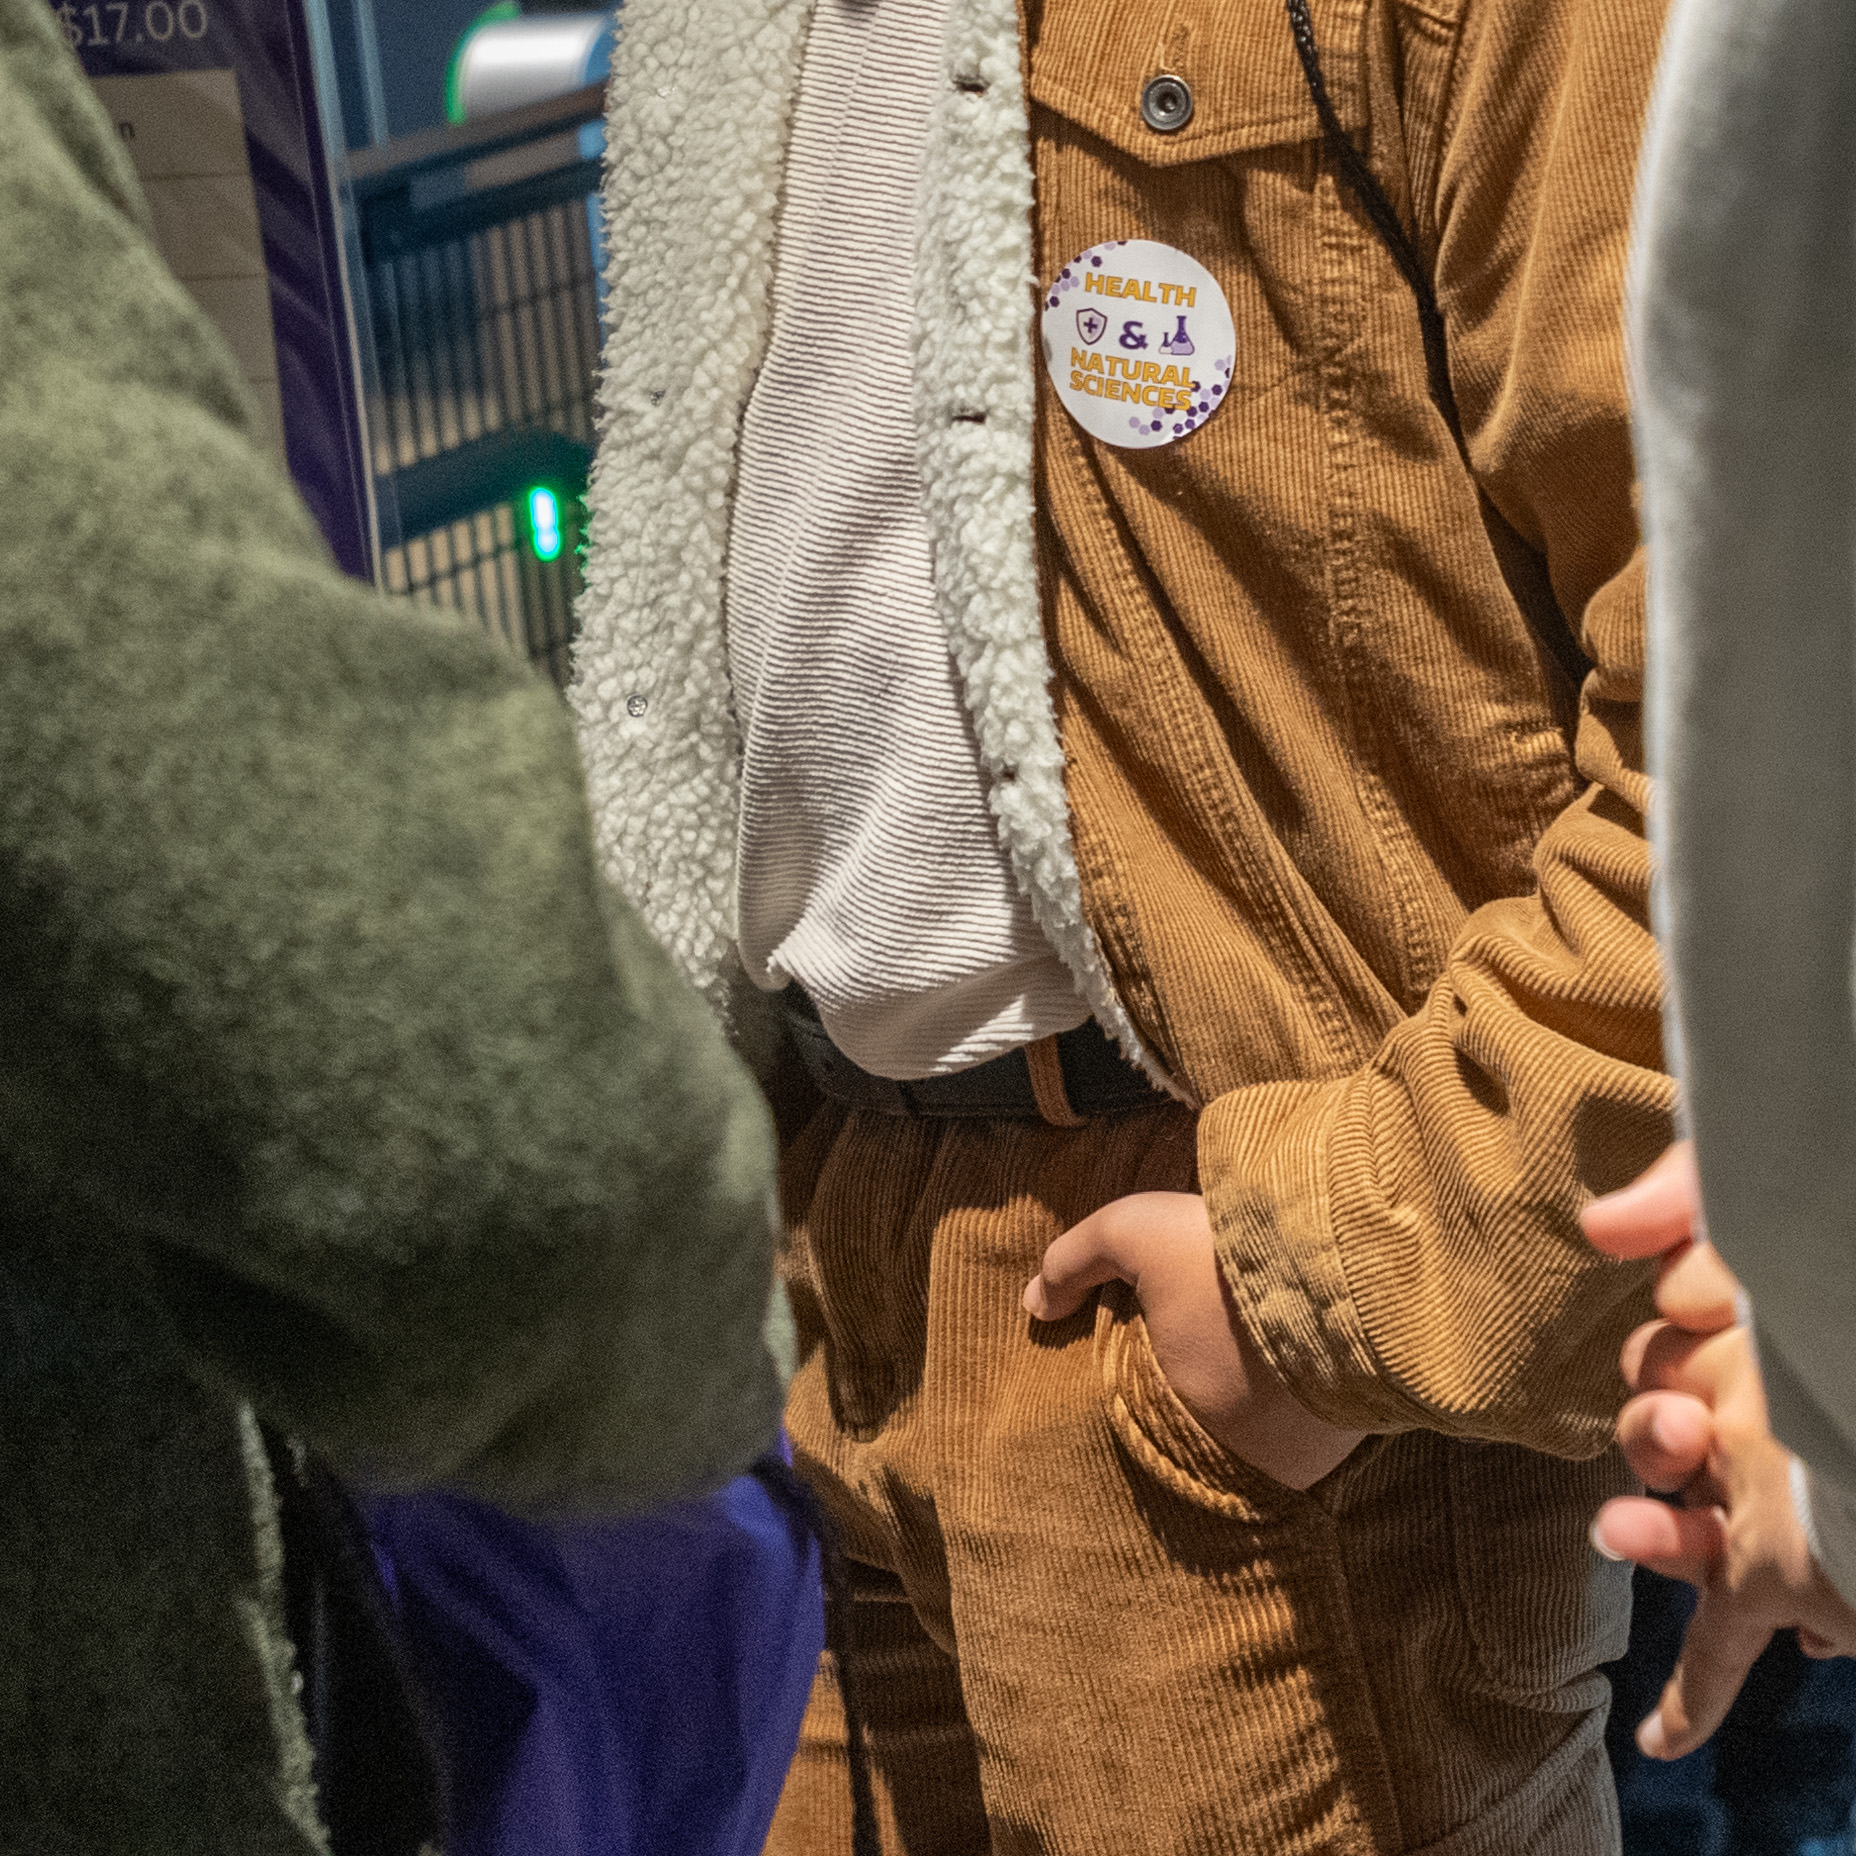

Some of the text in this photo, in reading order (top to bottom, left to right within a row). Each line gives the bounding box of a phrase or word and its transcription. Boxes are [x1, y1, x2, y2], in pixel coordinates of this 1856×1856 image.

[1084, 272, 1197, 308] HEALTH
[1118, 320, 1149, 350] &
[1070, 347, 1196, 388] NATURAL
[1069, 370, 1193, 411] SCIENCES
